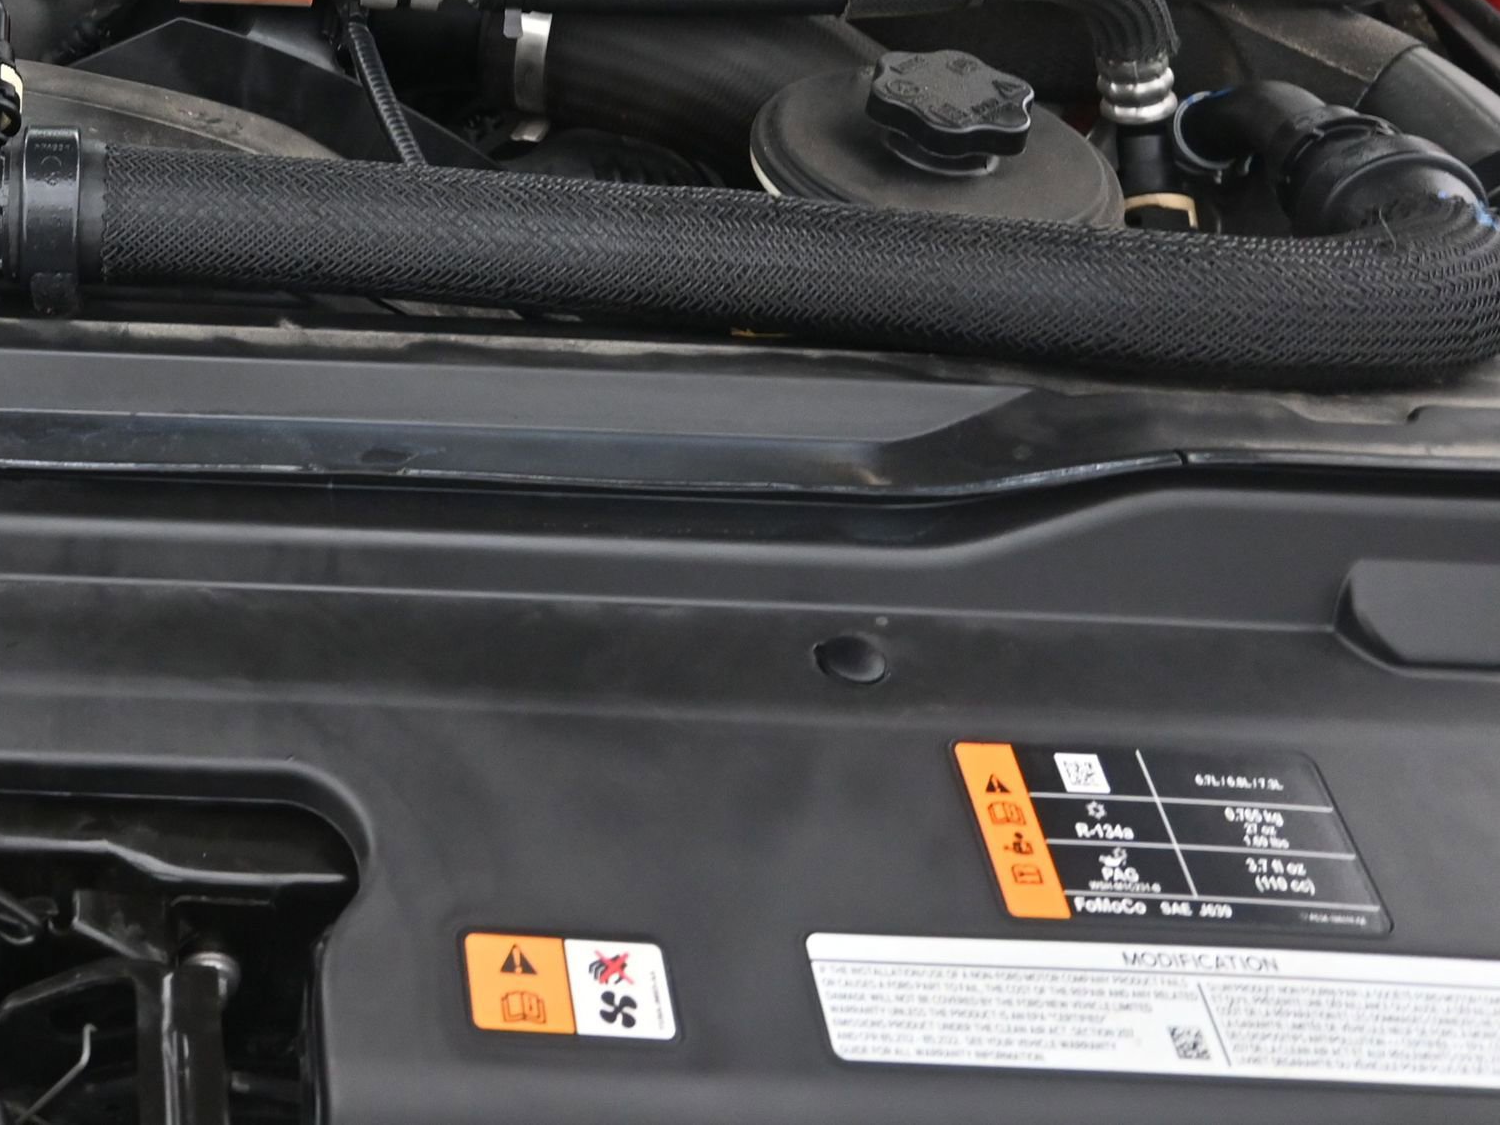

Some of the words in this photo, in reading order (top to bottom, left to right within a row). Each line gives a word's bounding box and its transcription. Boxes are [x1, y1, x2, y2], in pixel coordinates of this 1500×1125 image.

[1074, 822, 1135, 840] R-134a
[1073, 895, 1148, 916] FoMoCo
[1159, 900, 1194, 918] SAE
[1121, 951, 1280, 973] MODIFICATION
